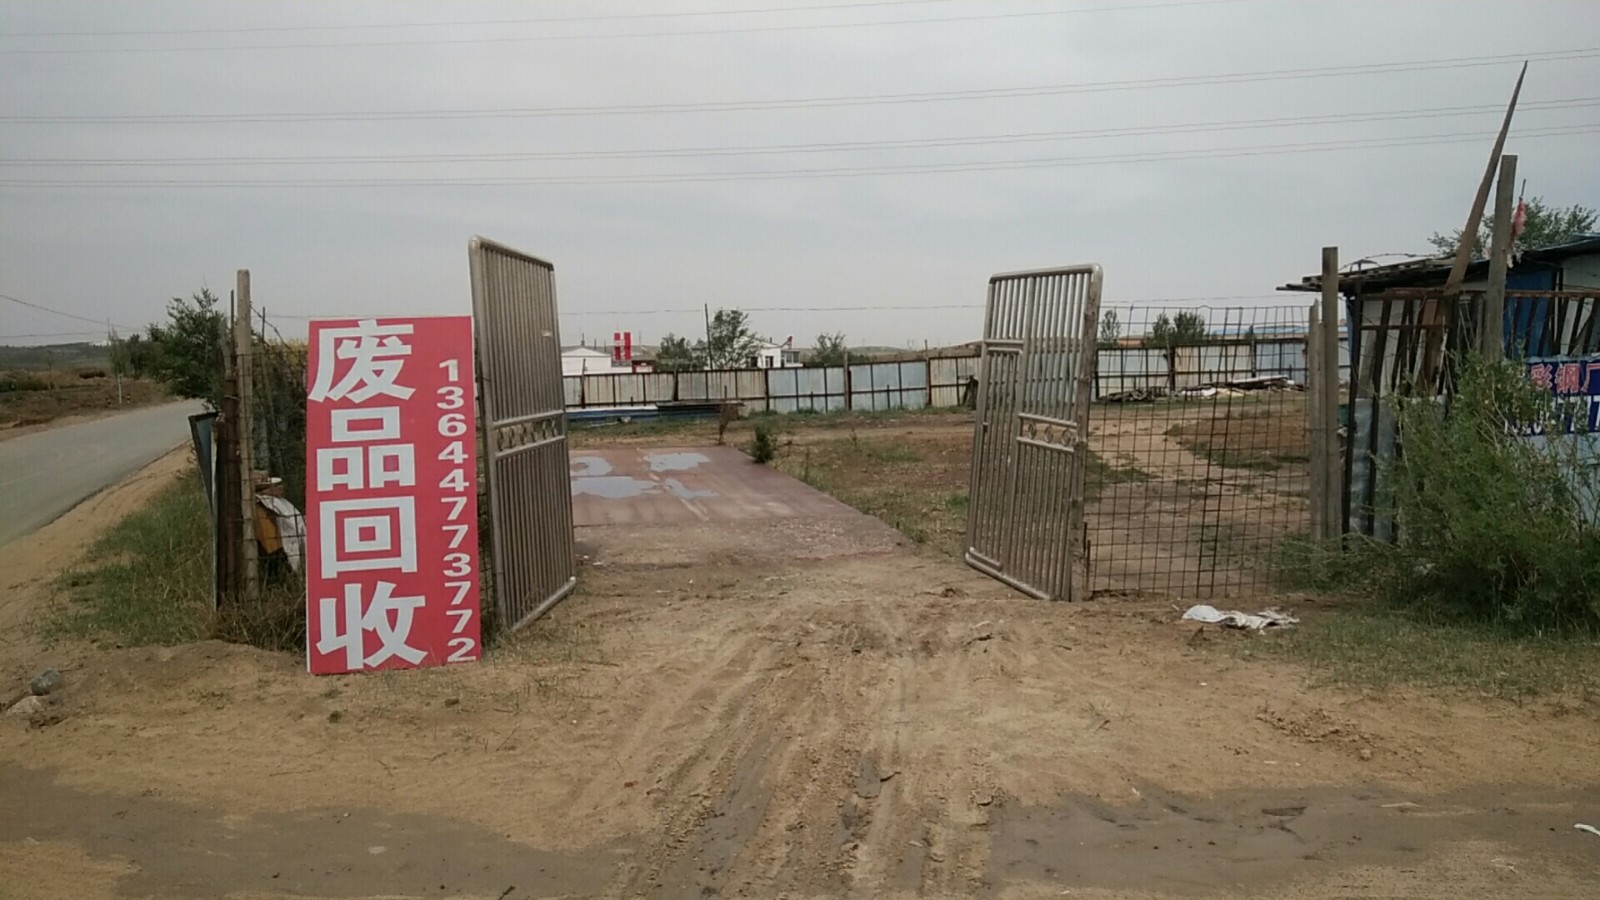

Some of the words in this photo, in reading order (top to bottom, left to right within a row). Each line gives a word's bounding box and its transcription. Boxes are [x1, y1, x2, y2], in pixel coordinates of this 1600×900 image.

[309, 319, 427, 670] 废品回收
[437, 359, 477, 663] 13644773772
